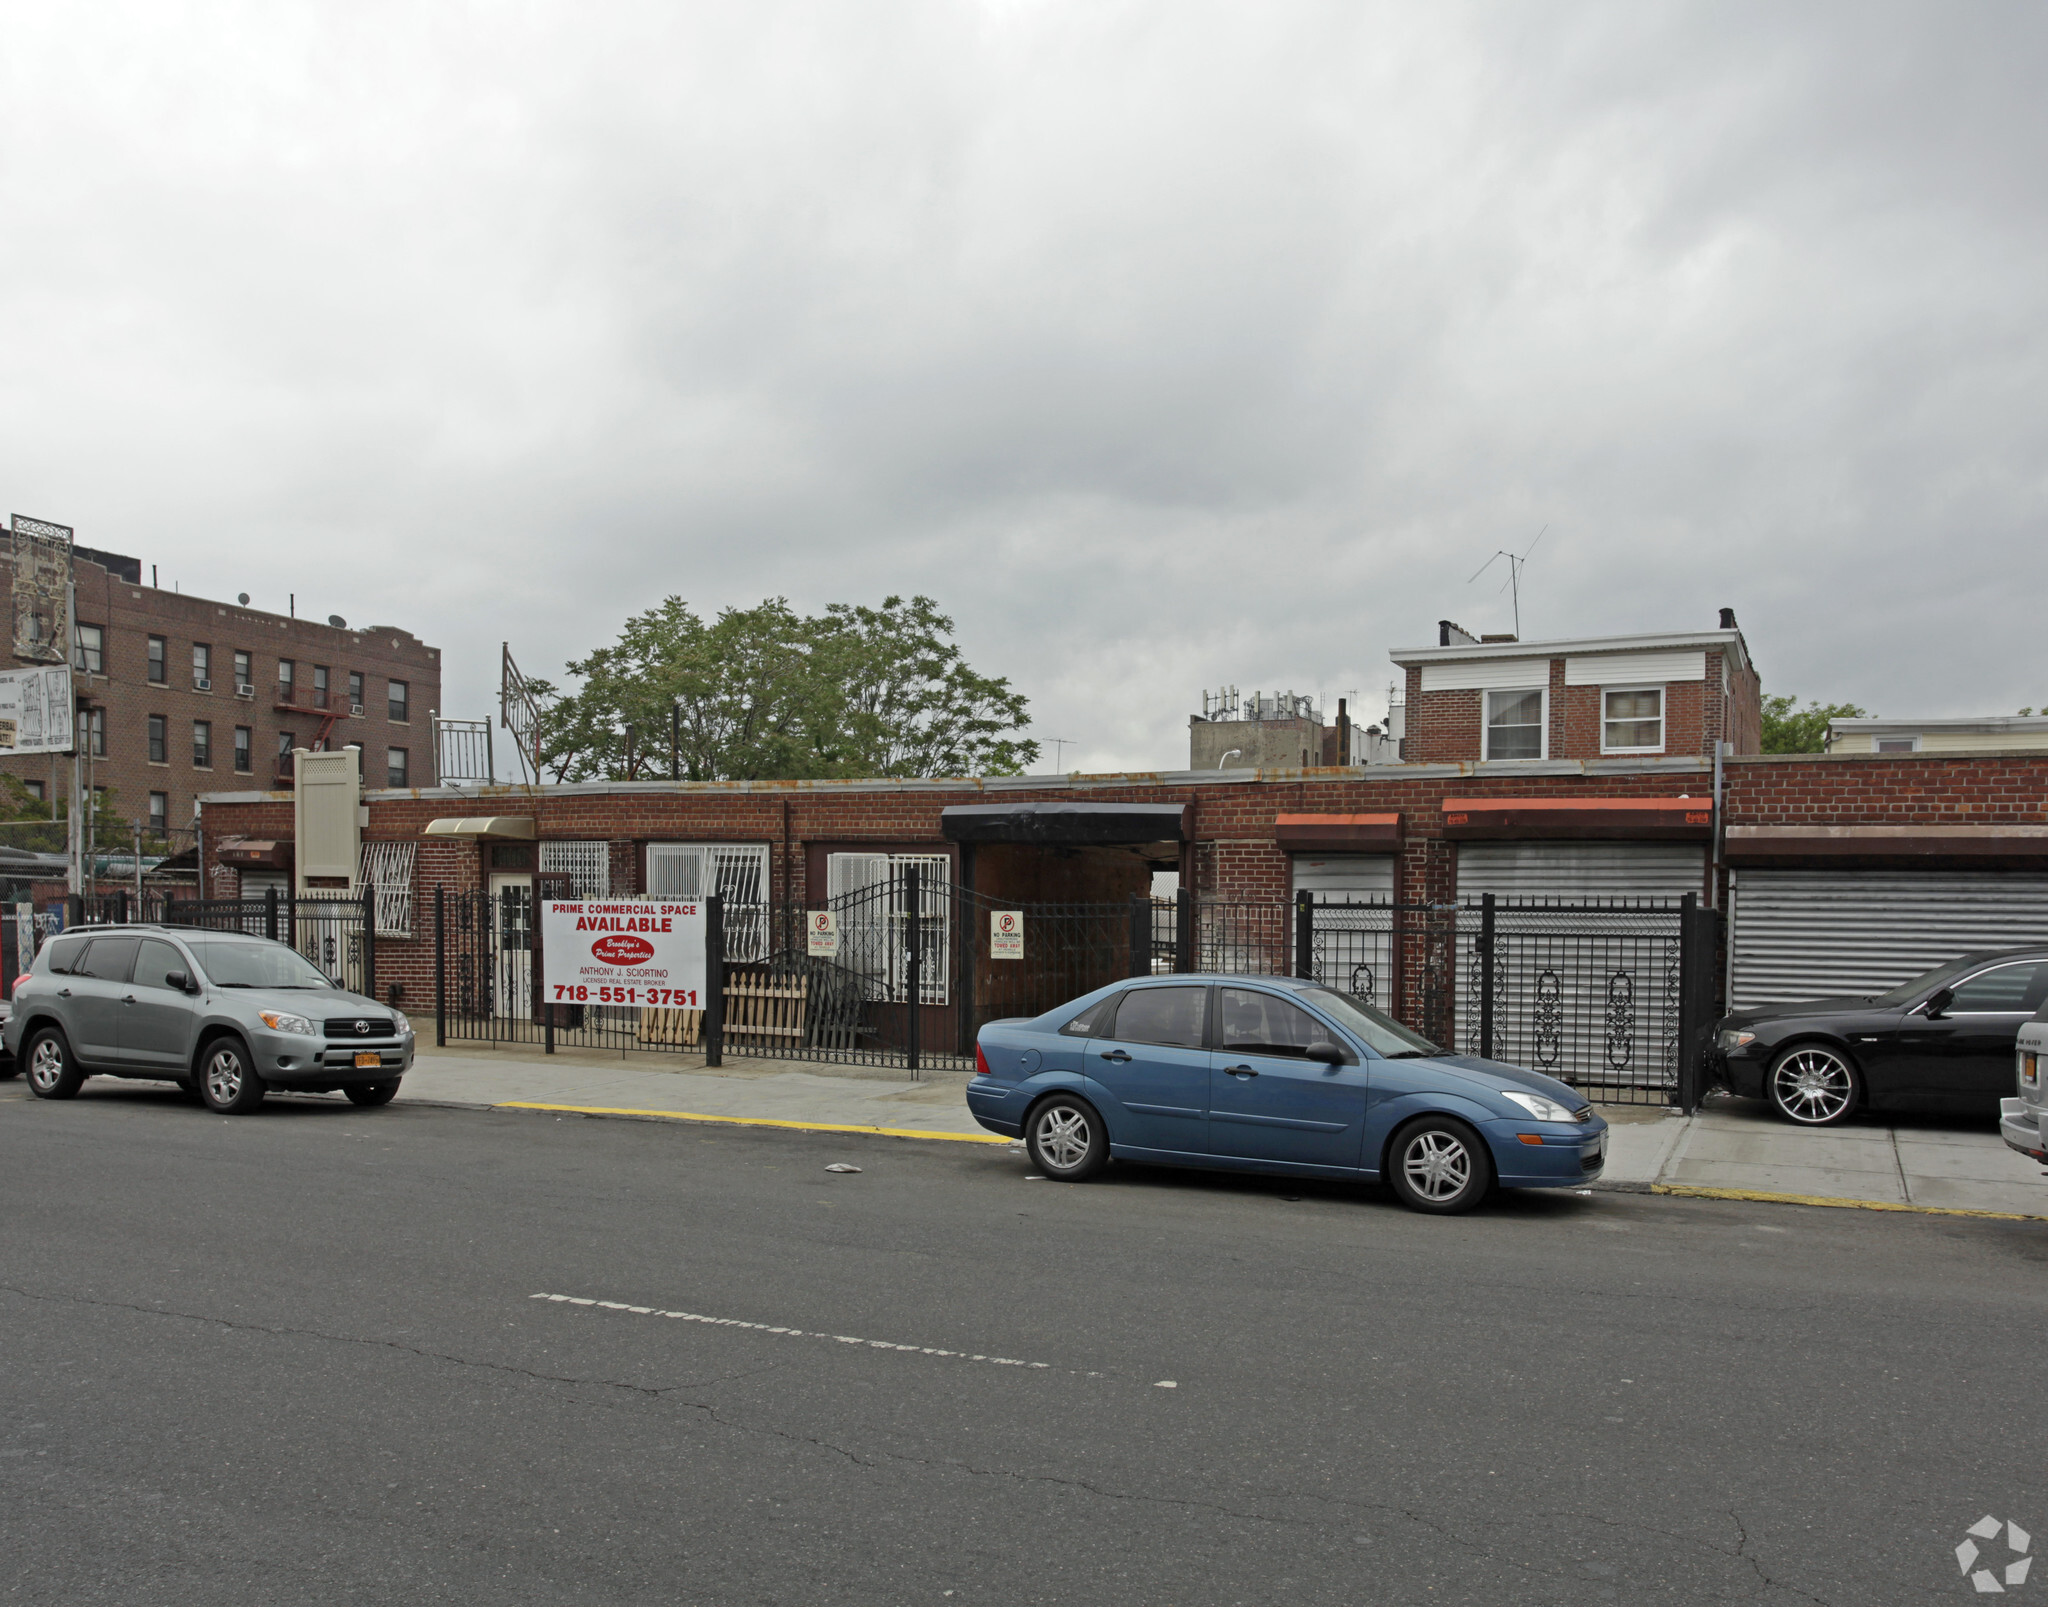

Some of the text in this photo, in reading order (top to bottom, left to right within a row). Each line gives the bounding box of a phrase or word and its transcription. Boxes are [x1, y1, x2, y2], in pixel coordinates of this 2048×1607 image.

[553, 904, 696, 915] PRIME COMMERCIAL SPACE
[576, 917, 672, 932] AVAILABLE
[607, 939, 639, 949] Brooklyn's
[596, 949, 651, 959] Prime Properties
[580, 967, 668, 978] ANTHONY J. SCIORTINO
[554, 985, 696, 1006] 718-551-3751
